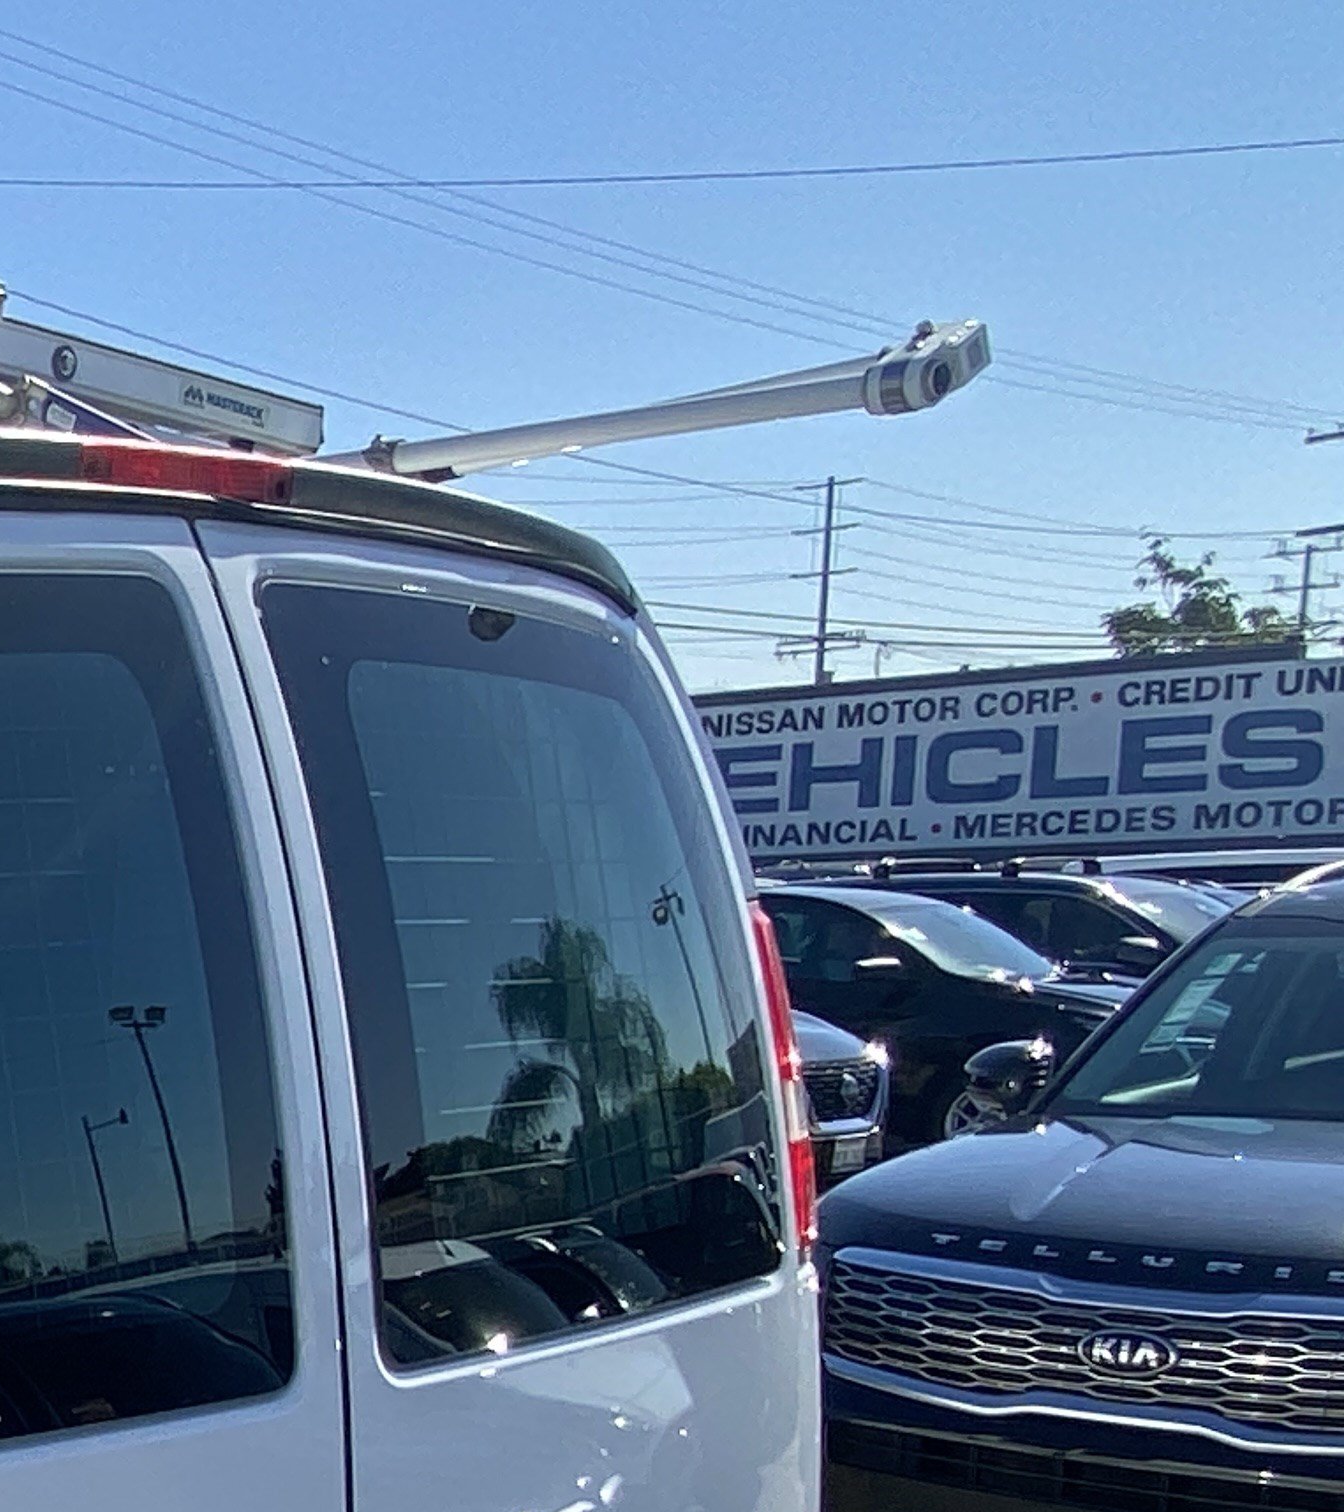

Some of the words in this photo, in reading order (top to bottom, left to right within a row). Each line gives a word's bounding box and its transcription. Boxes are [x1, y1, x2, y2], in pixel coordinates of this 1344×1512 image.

[702, 706, 826, 738] NISSAN
[837, 695, 959, 728] MOTOR
[975, 688, 1078, 719] CORP.
[1118, 672, 1262, 706] CREDIT
[953, 806, 1176, 840] MERCEDES
[1091, 1337, 1158, 1367] KIA
